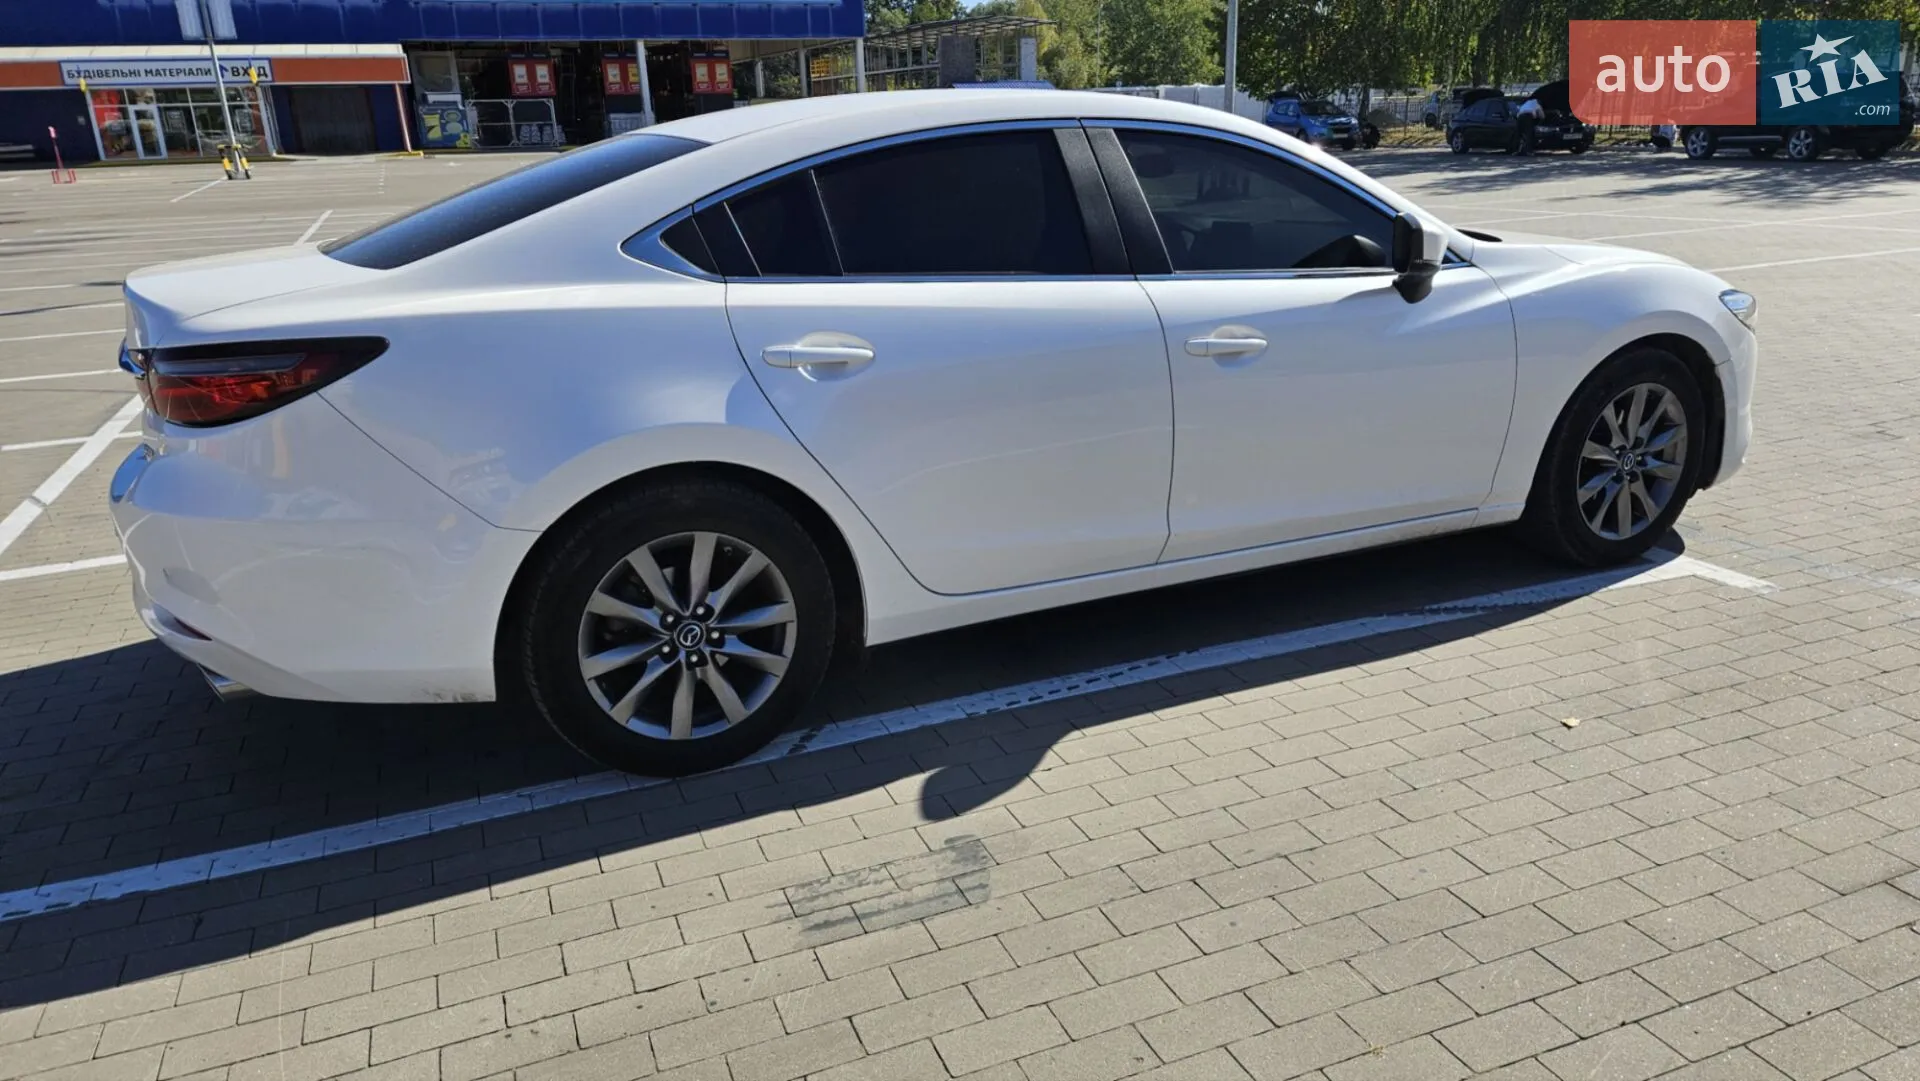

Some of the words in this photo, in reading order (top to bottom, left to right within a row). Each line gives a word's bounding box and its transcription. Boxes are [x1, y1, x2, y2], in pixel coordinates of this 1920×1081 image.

[66, 68, 141, 79] БУДІВЕЛЬНІ
[144, 67, 212, 77] МАТЕРІАЛИ
[231, 66, 268, 78] ВХД
